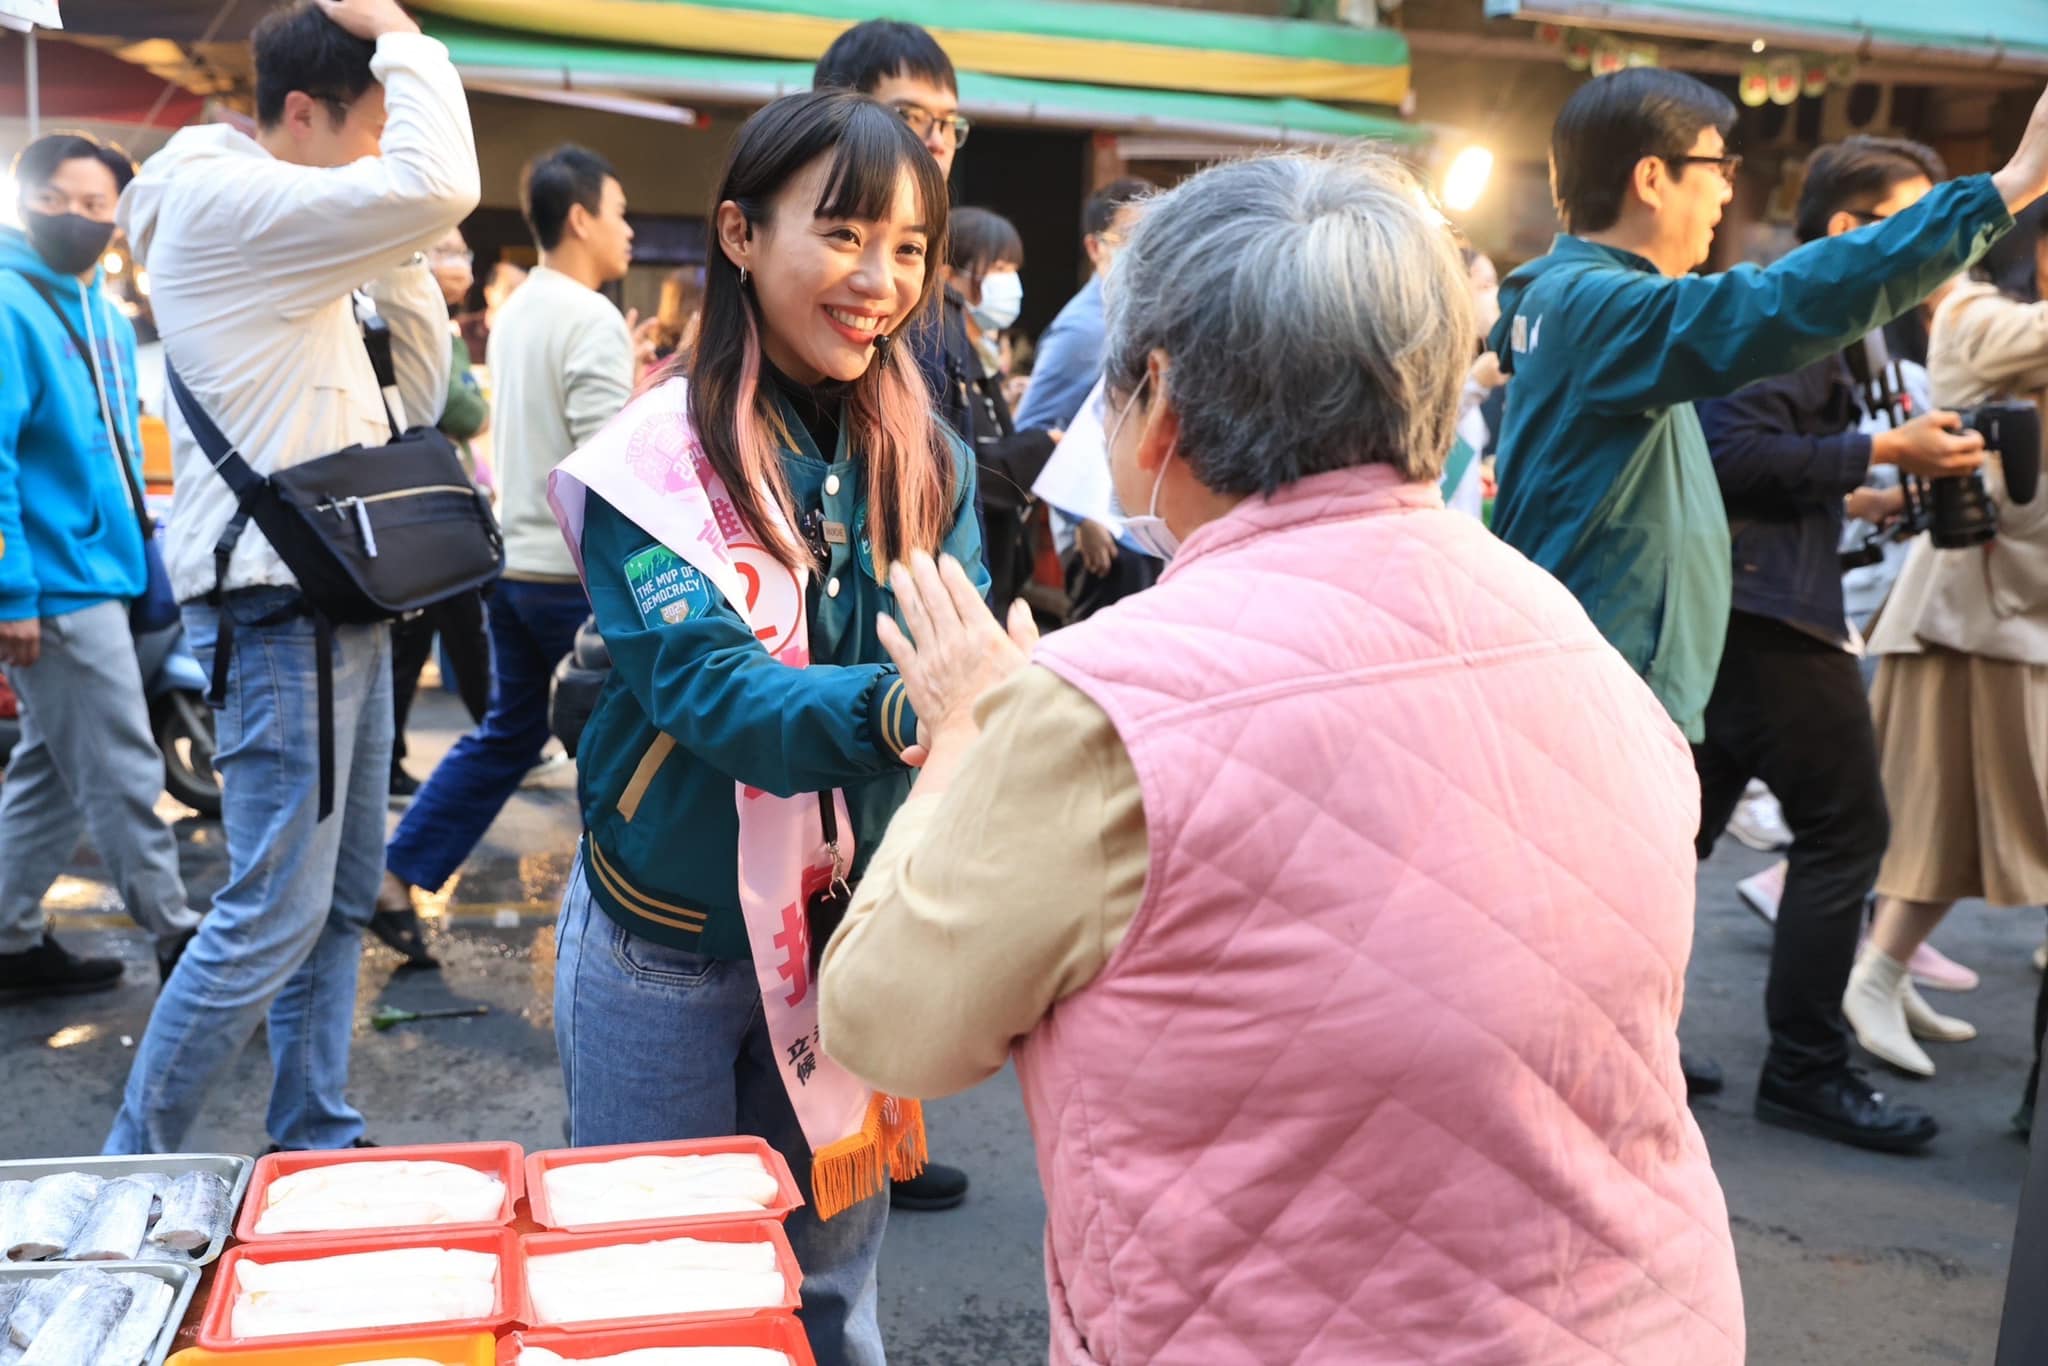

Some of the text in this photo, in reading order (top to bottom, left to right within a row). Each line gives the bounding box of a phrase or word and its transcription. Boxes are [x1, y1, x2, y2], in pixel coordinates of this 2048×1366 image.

[636, 565, 696, 599] THE MVP OF
[641, 579, 700, 614] DEMOCRACY
[663, 599, 687, 617] 2024
